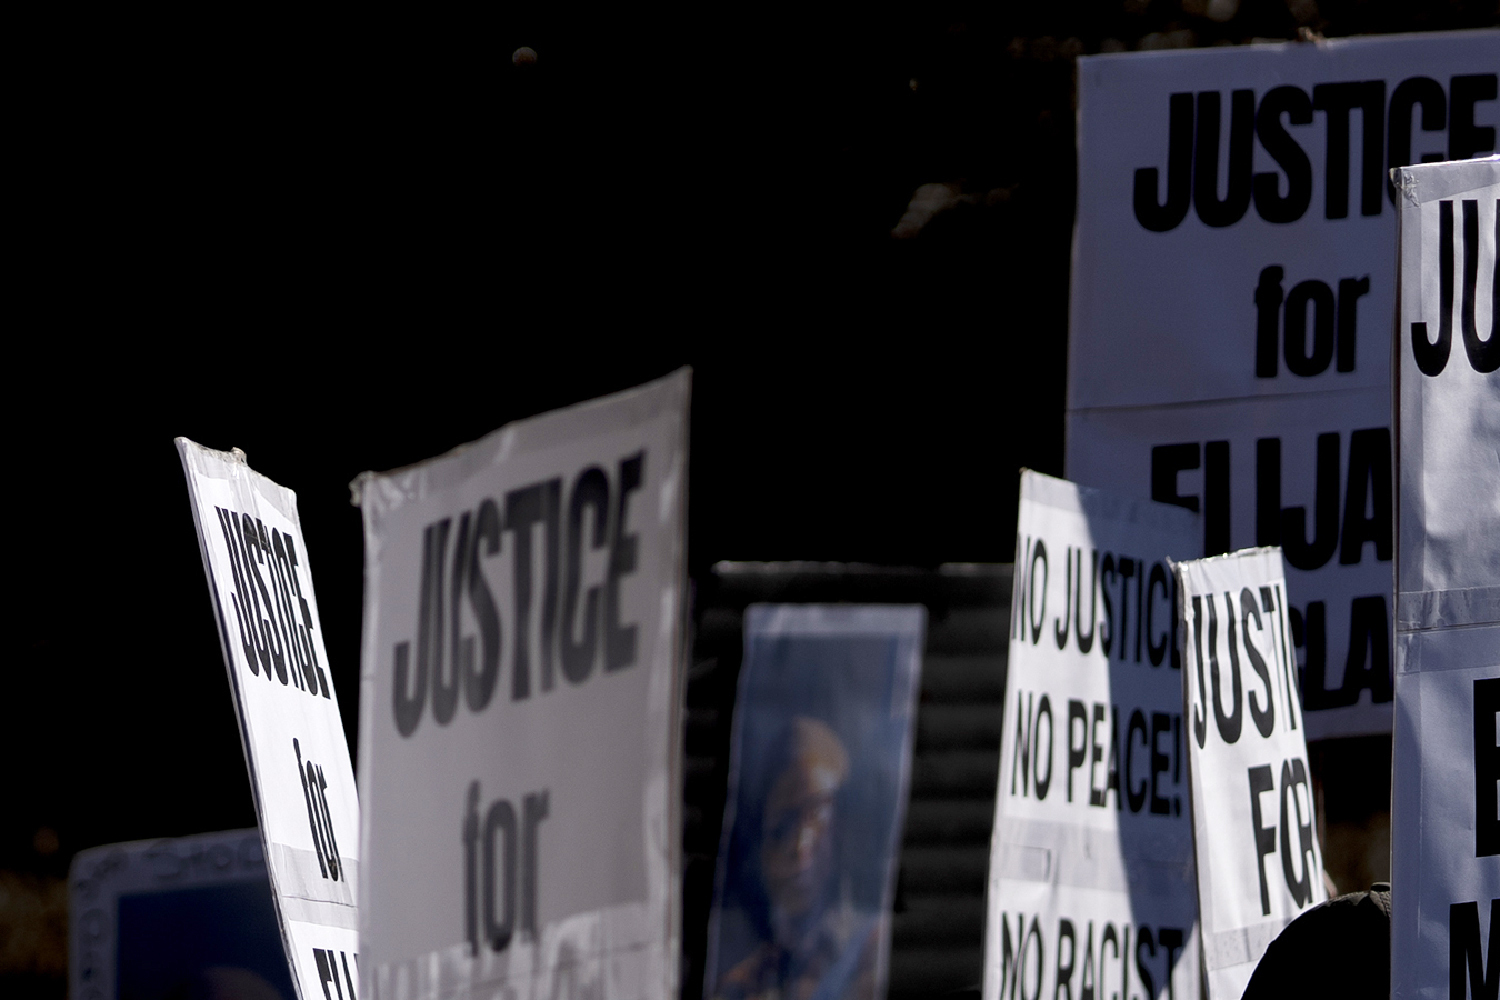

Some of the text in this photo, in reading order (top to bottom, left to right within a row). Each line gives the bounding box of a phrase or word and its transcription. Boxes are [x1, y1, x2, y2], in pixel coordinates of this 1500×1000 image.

[1134, 74, 1498, 232] JUSTICE
[1256, 266, 1369, 378] for
[1152, 428, 1392, 570] ELIJA
[214, 506, 331, 700] JUSTICE
[391, 450, 648, 738] JUSTICE
[1012, 533, 1048, 646] NO
[1192, 587, 1297, 749] JUSTI
[292, 737, 345, 882] for
[1011, 689, 1181, 817] NO PEACE!
[462, 779, 549, 958] for
